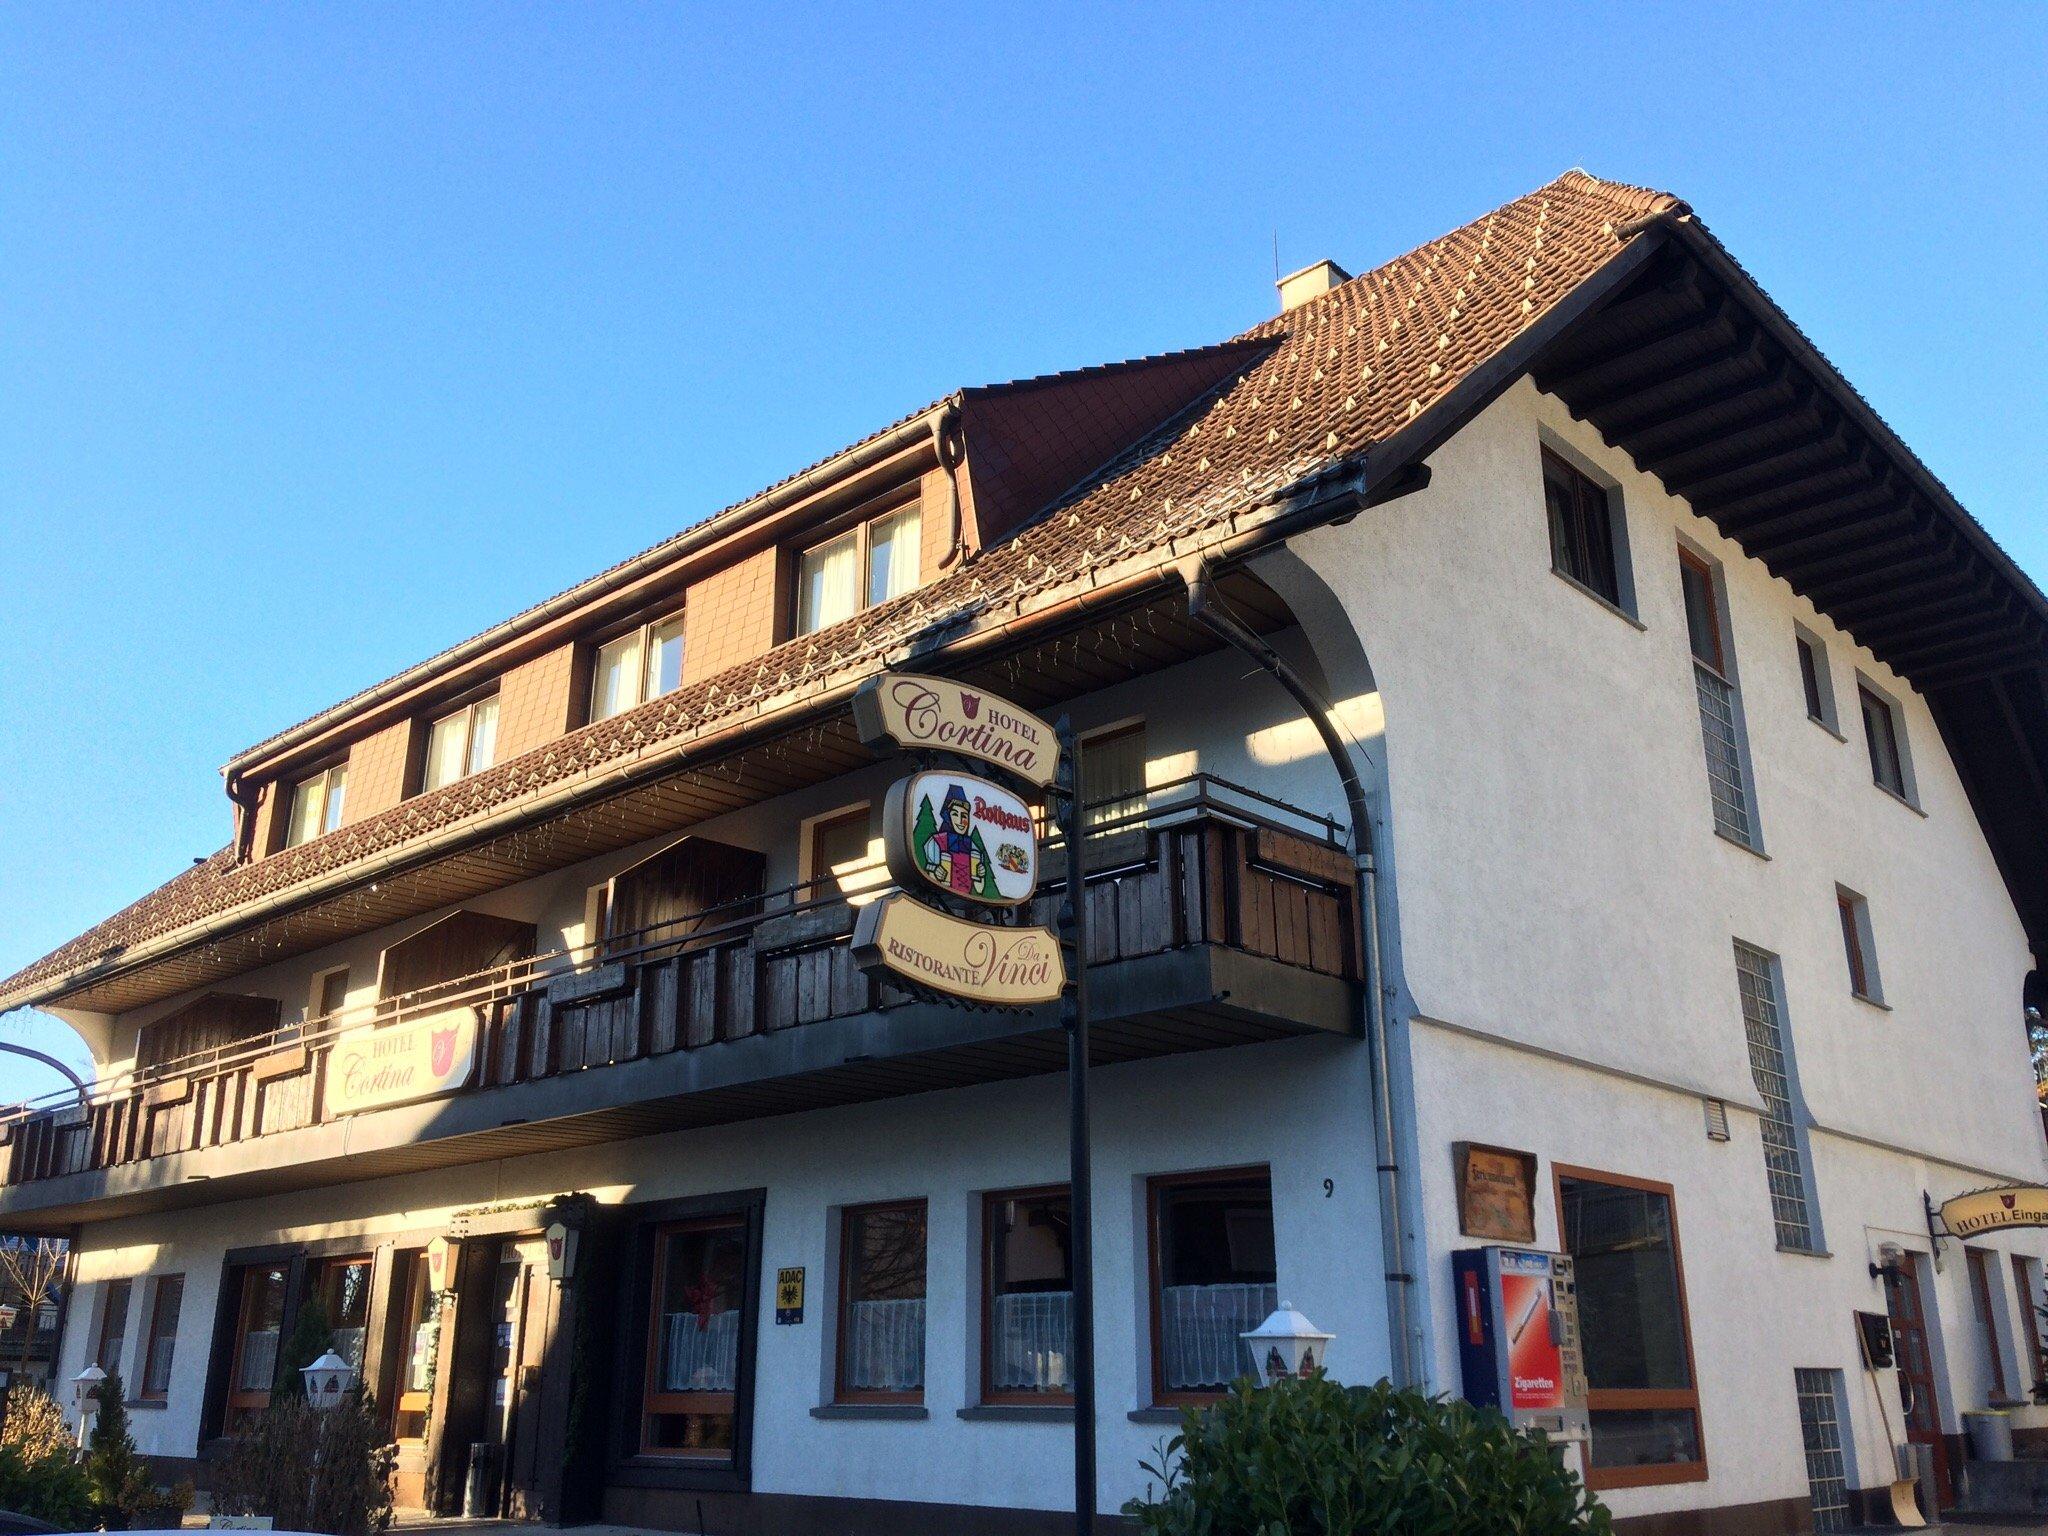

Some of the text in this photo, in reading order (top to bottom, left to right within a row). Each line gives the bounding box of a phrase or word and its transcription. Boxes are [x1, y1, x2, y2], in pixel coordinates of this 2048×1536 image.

[892, 681, 1037, 772] Cortina
[988, 708, 1040, 746] HOTEL
[973, 795, 1030, 834] Rothaus
[887, 936, 980, 986] RISTORANTE
[964, 931, 1053, 987] Da Vinci
[372, 1033, 415, 1059] HOTEL
[342, 1052, 415, 1099] Cortina
[1323, 1178, 1334, 1198] 9
[1956, 1211, 2011, 1233] HOTEL
[779, 1270, 802, 1284] ADAC
[1515, 1376, 1554, 1392] Zigaretten
